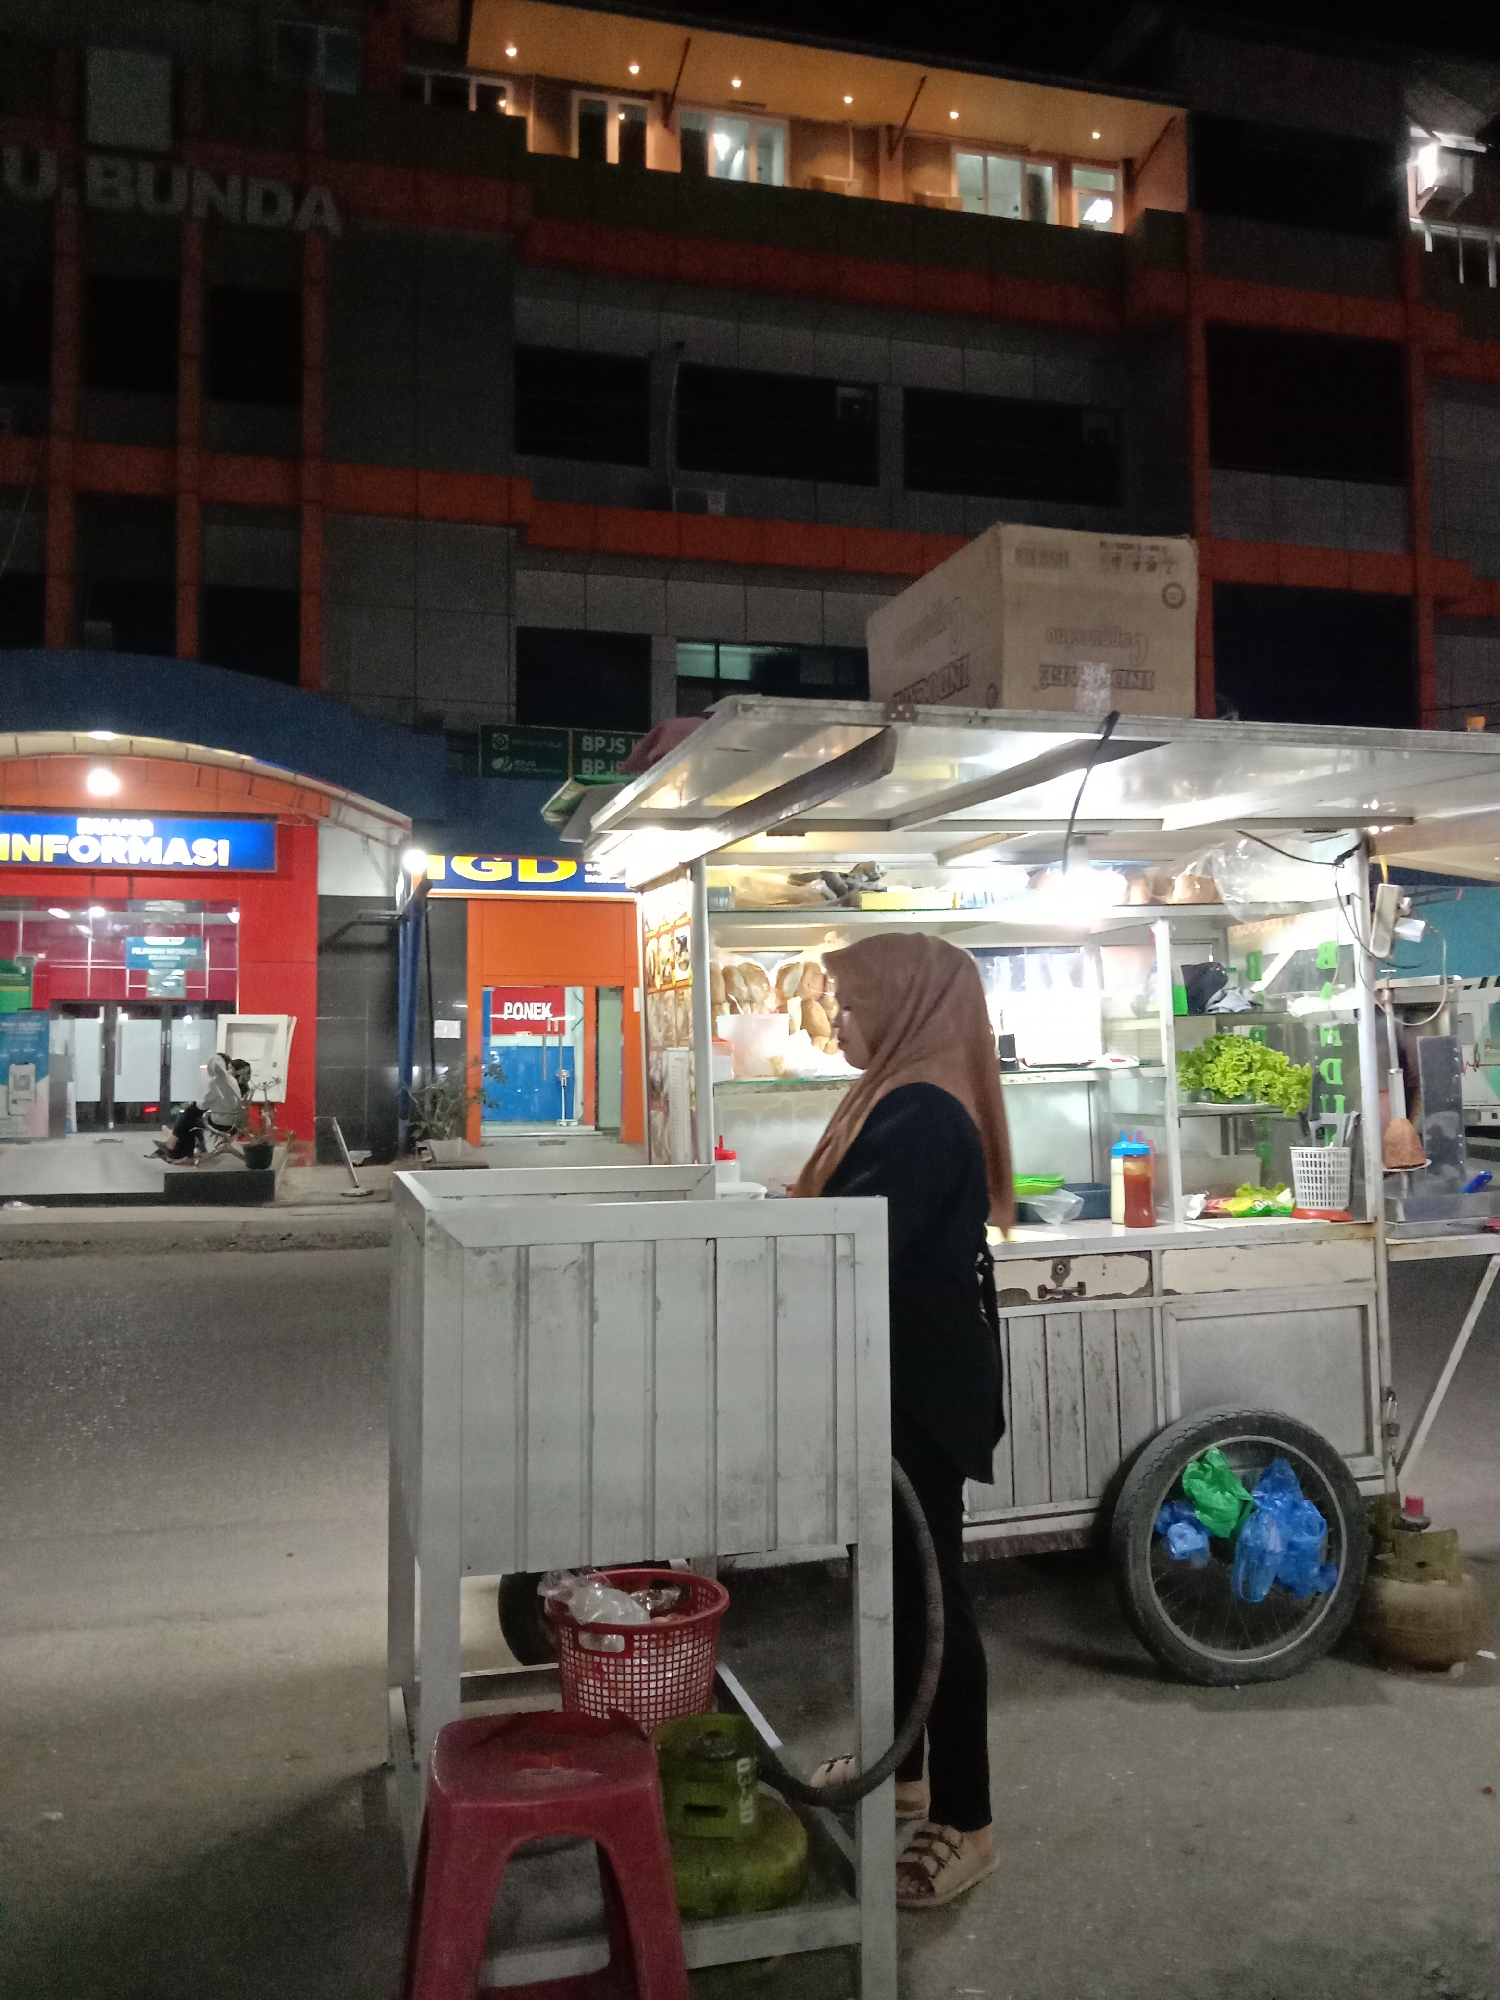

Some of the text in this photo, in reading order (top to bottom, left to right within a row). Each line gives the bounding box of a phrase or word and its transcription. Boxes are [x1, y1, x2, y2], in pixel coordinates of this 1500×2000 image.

[85, 153, 344, 238] BUNDA
[582, 735, 626, 754] BPJS
[0, 833, 230, 867] INFORMASI
[426, 855, 578, 883] IGD
[503, 1002, 553, 1020] PONEK
